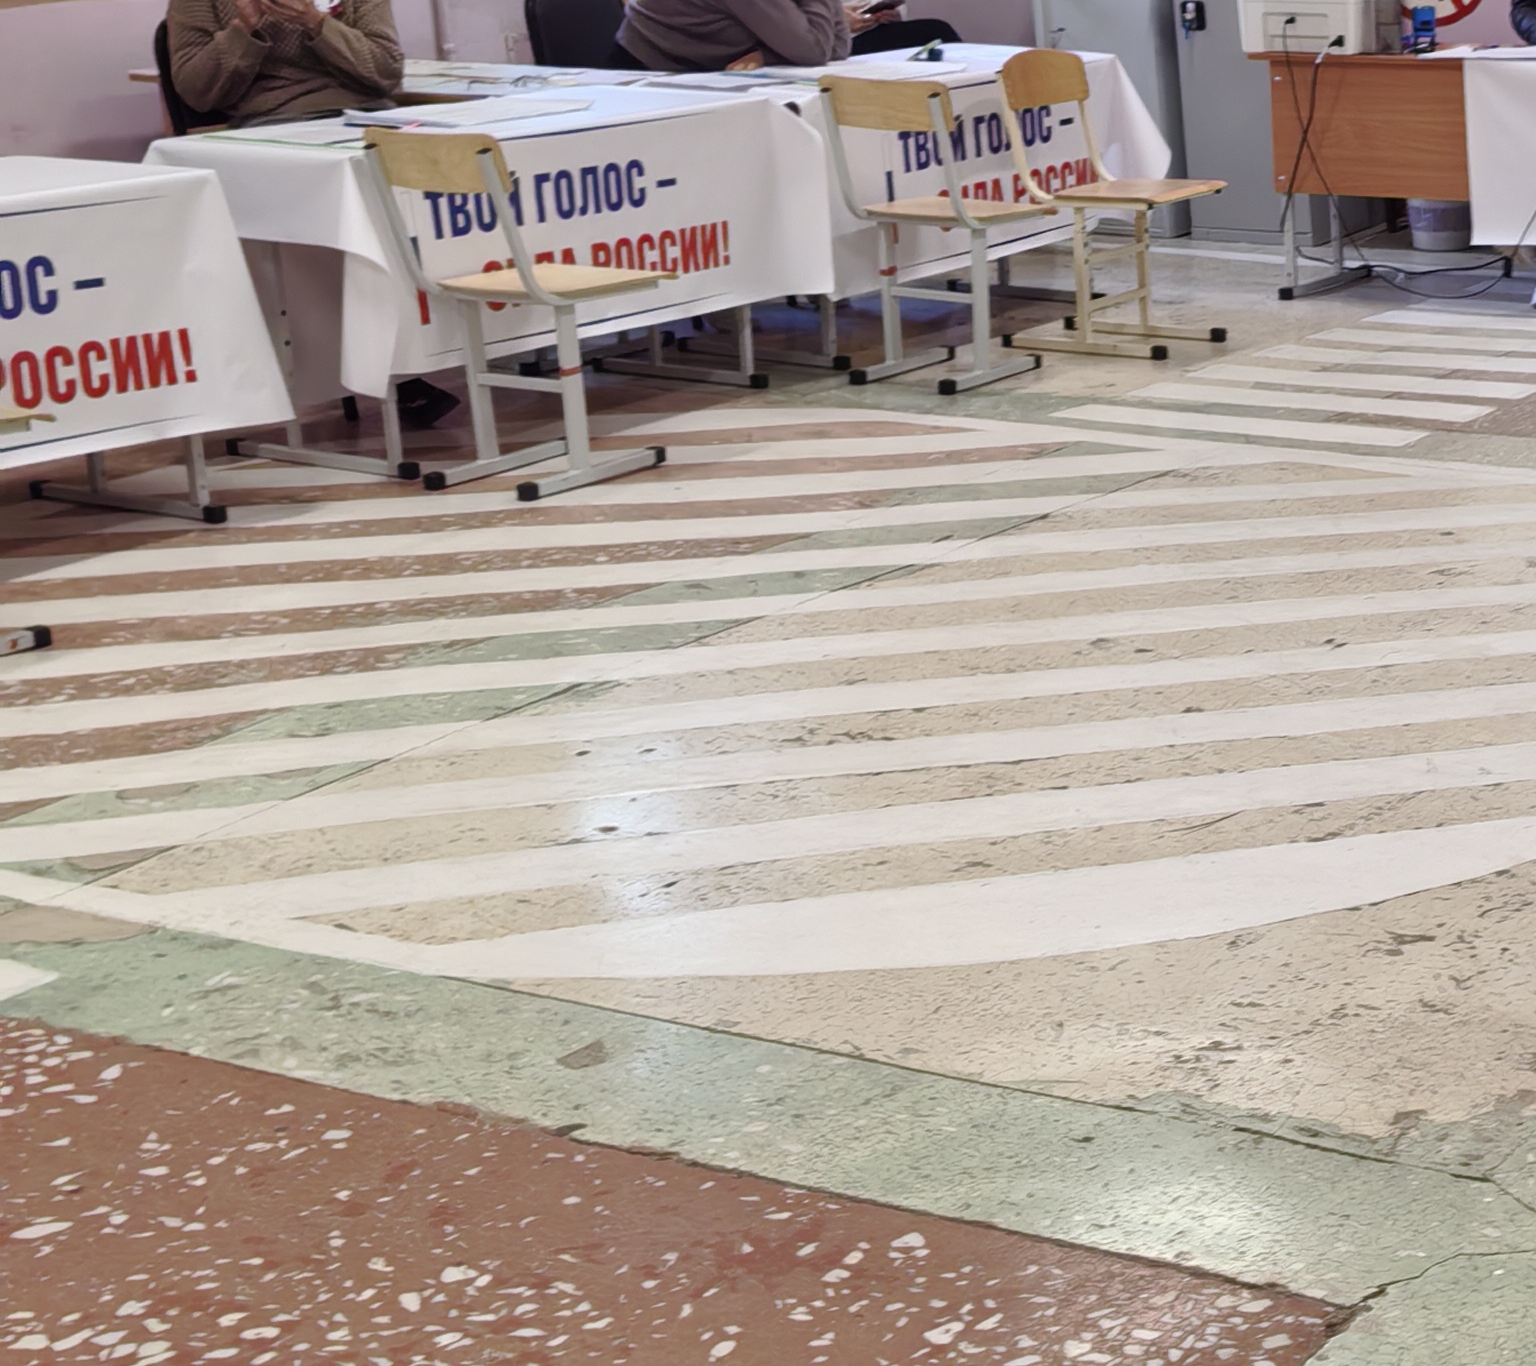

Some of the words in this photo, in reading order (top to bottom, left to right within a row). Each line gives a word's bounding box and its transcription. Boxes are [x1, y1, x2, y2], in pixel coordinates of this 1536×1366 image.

[973, 105, 1053, 158] ГООС
[533, 159, 648, 224] ГОЛОС
[591, 220, 730, 274] РОССИИ!
[0, 327, 198, 409] ОССИИ!
